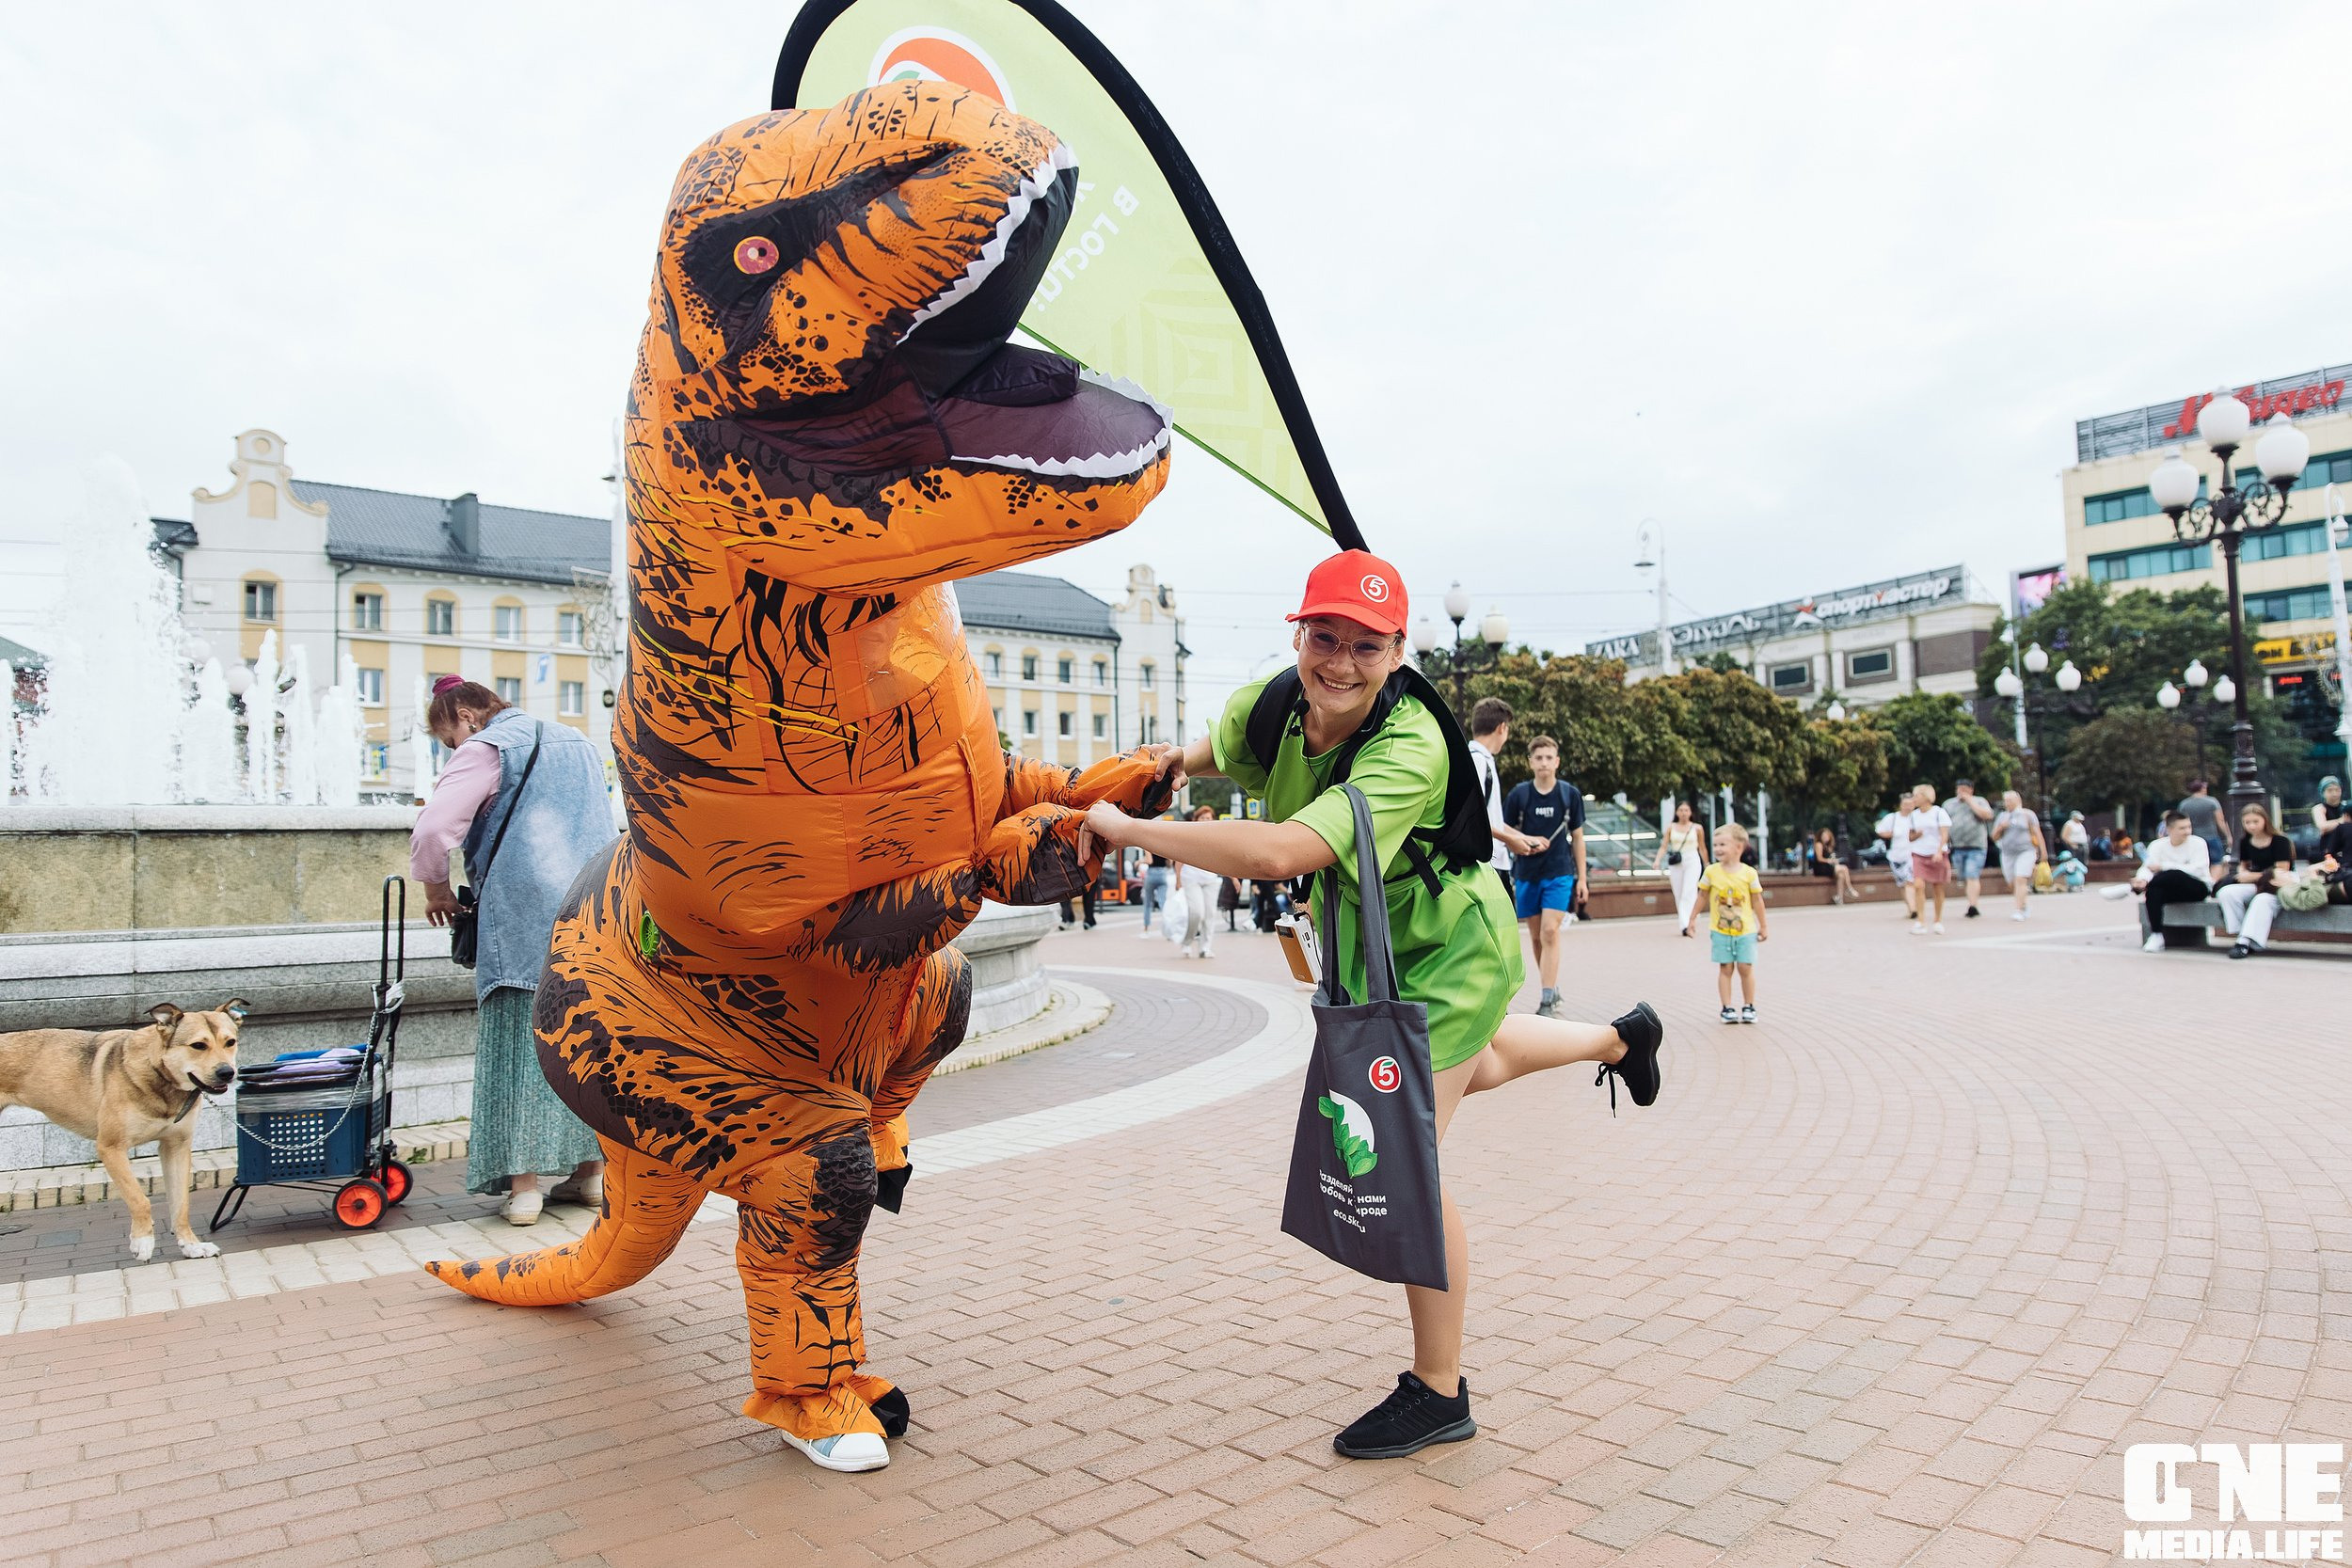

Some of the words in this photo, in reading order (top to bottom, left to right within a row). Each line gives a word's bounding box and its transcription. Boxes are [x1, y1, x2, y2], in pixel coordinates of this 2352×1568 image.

[1319, 1169, 1354, 1195] азделяй
[1357, 1195, 1387, 1204] нами
[1355, 1205, 1388, 1217] ироде
